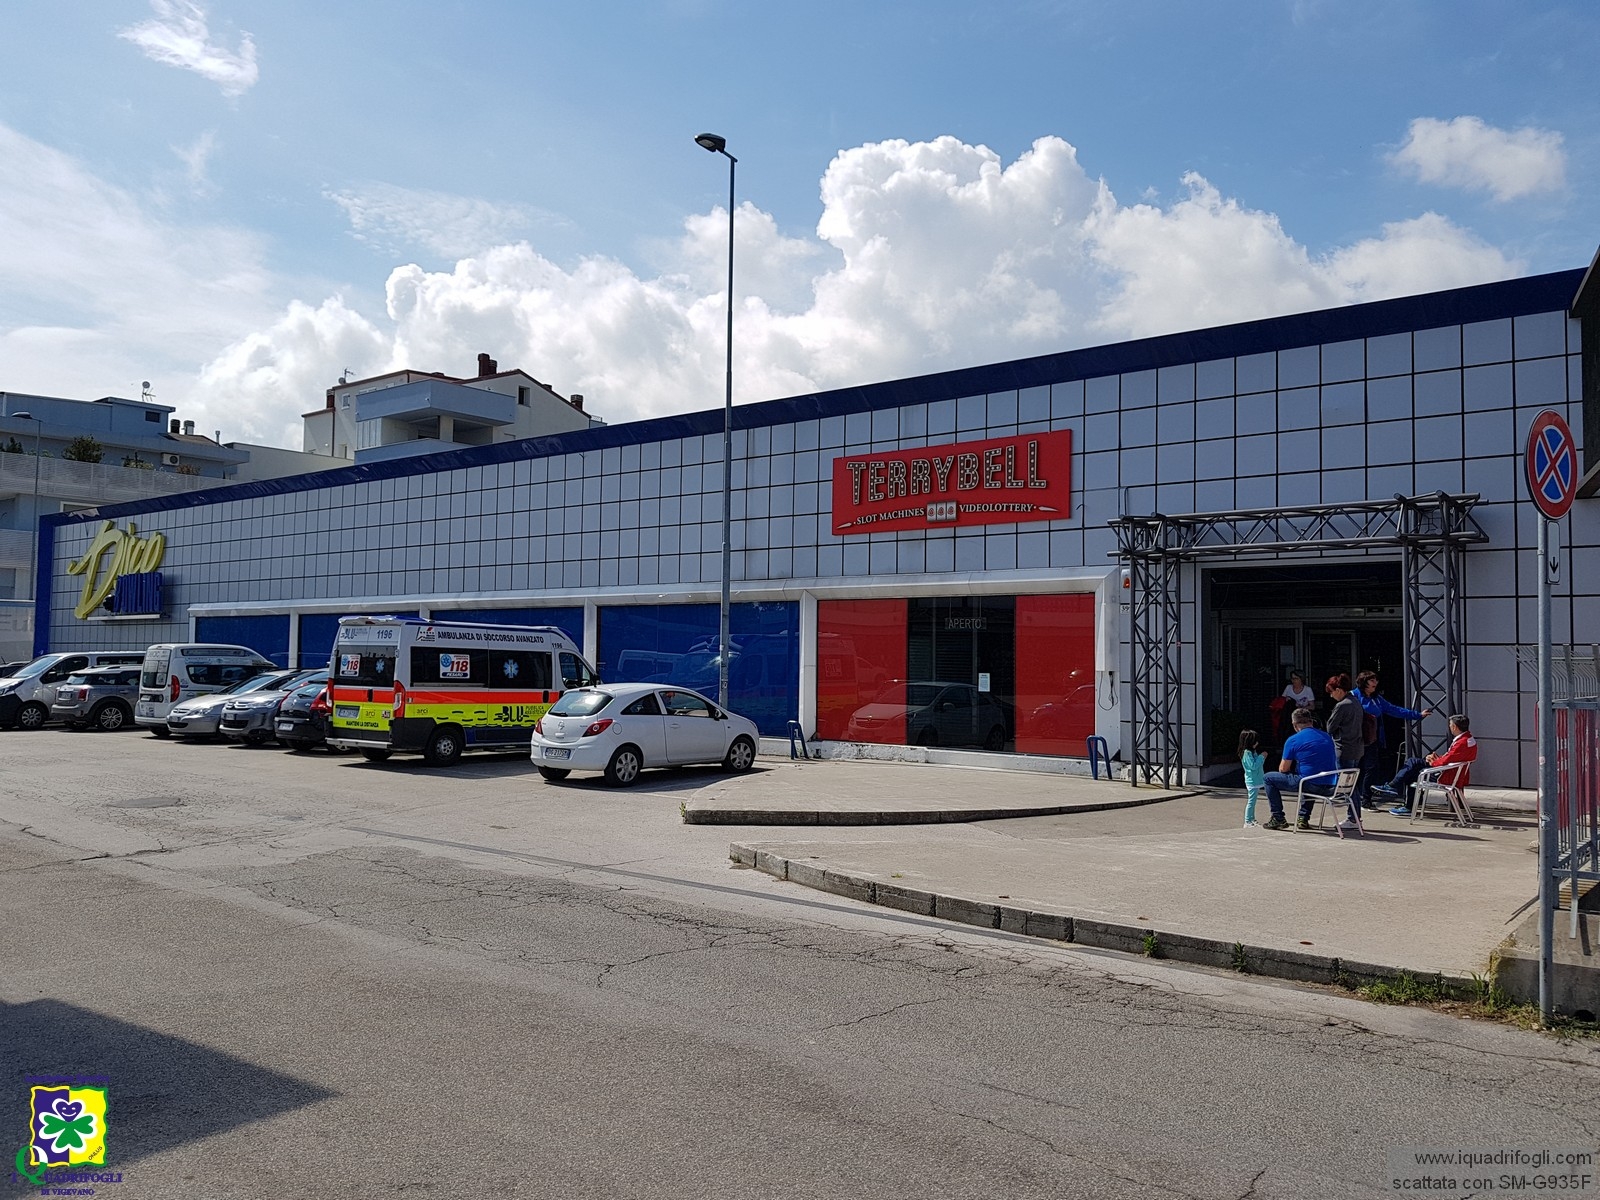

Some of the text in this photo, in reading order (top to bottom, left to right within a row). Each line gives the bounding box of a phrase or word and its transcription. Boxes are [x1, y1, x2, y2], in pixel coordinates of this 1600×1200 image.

[847, 440, 1047, 505] TERRYBELL
[856, 503, 1033, 525] SLOT MACHINES VIDEOLOTTERY
[948, 618, 982, 630] APERTO
[377, 630, 393, 639] 1196
[437, 631, 475, 641] AMBULANZA
[484, 634, 515, 642] SOCCORSO
[515, 635, 544, 644] AVANZATO
[346, 660, 359, 670] 118
[450, 661, 469, 672] 118
[502, 705, 524, 723] BLU
